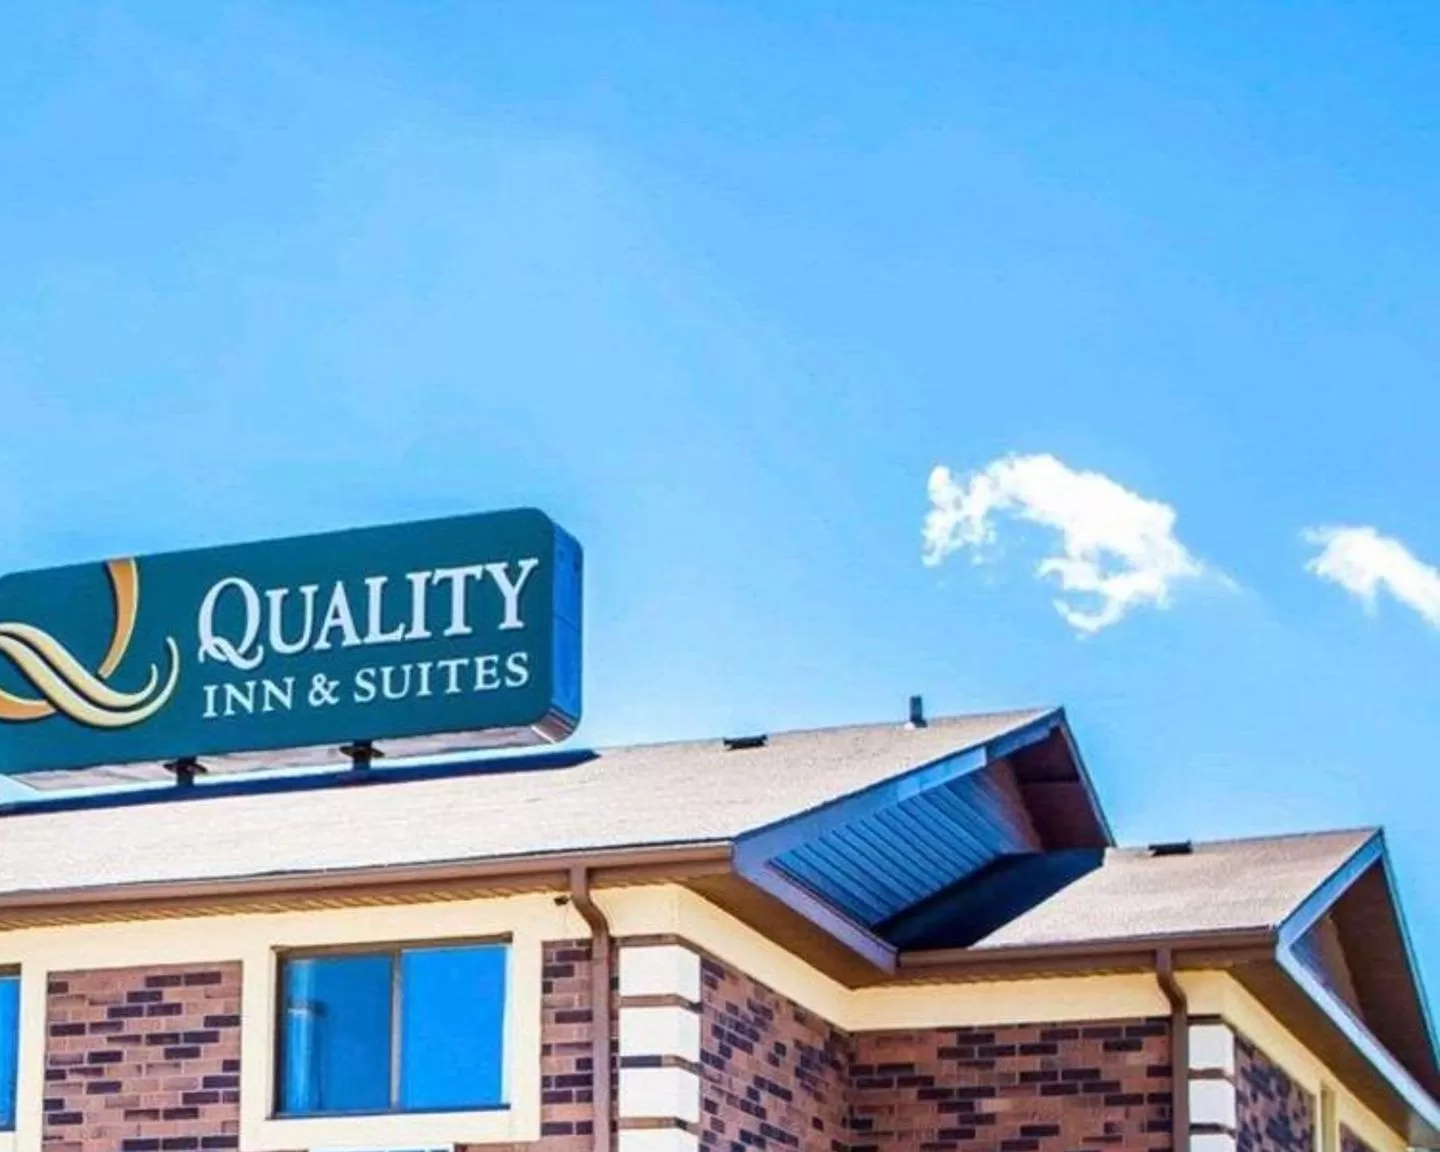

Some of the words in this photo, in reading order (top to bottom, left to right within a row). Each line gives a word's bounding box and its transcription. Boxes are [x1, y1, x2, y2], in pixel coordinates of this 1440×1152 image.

[198, 558, 538, 669] QUALITY
[204, 678, 294, 717] INN
[308, 673, 338, 706] &
[355, 655, 529, 700] SUITES
